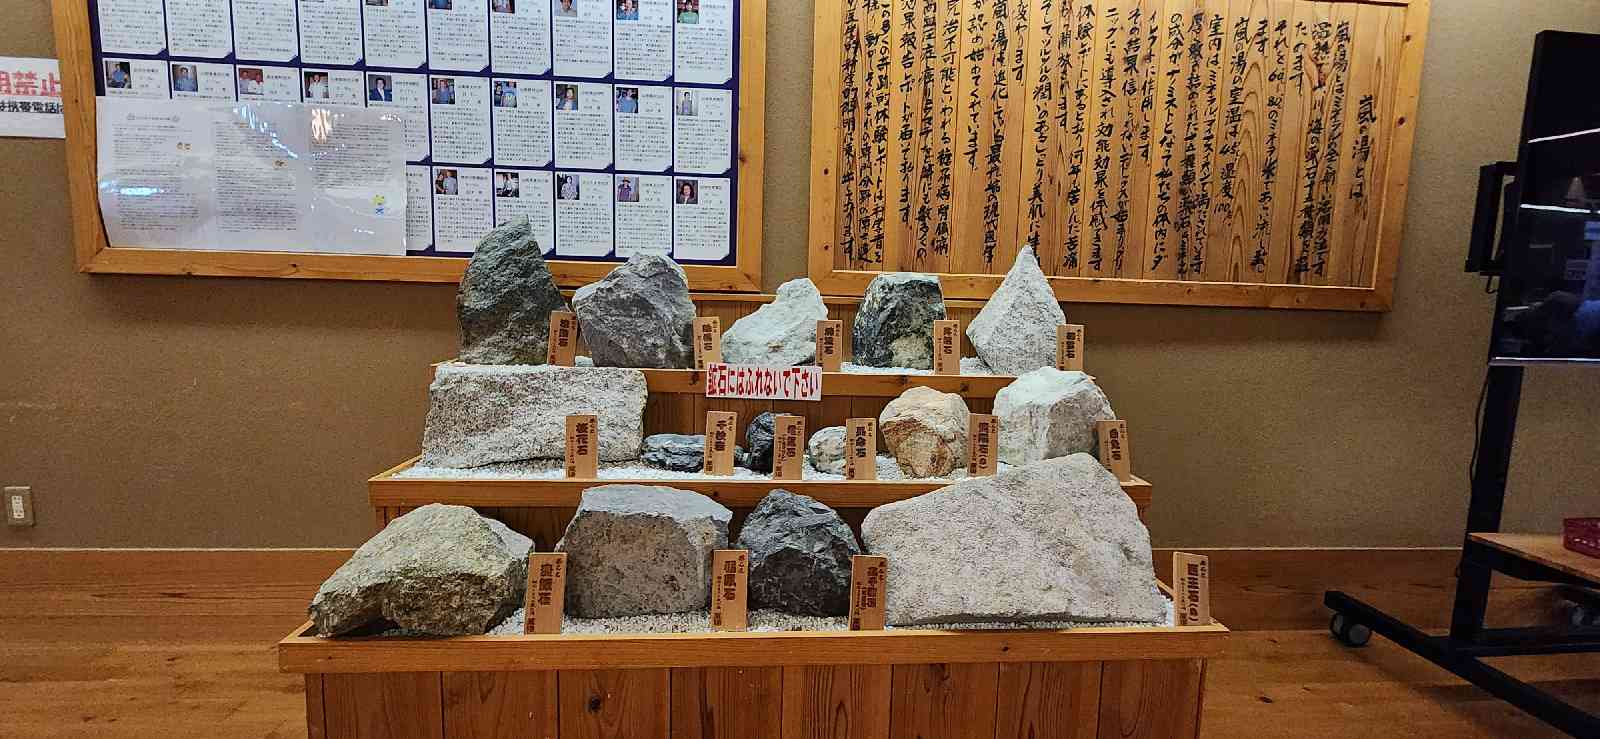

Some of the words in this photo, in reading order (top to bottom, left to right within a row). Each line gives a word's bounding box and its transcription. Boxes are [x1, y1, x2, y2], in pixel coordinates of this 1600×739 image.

[708, 364, 819, 398] 鉱石にはふれないで下さい
